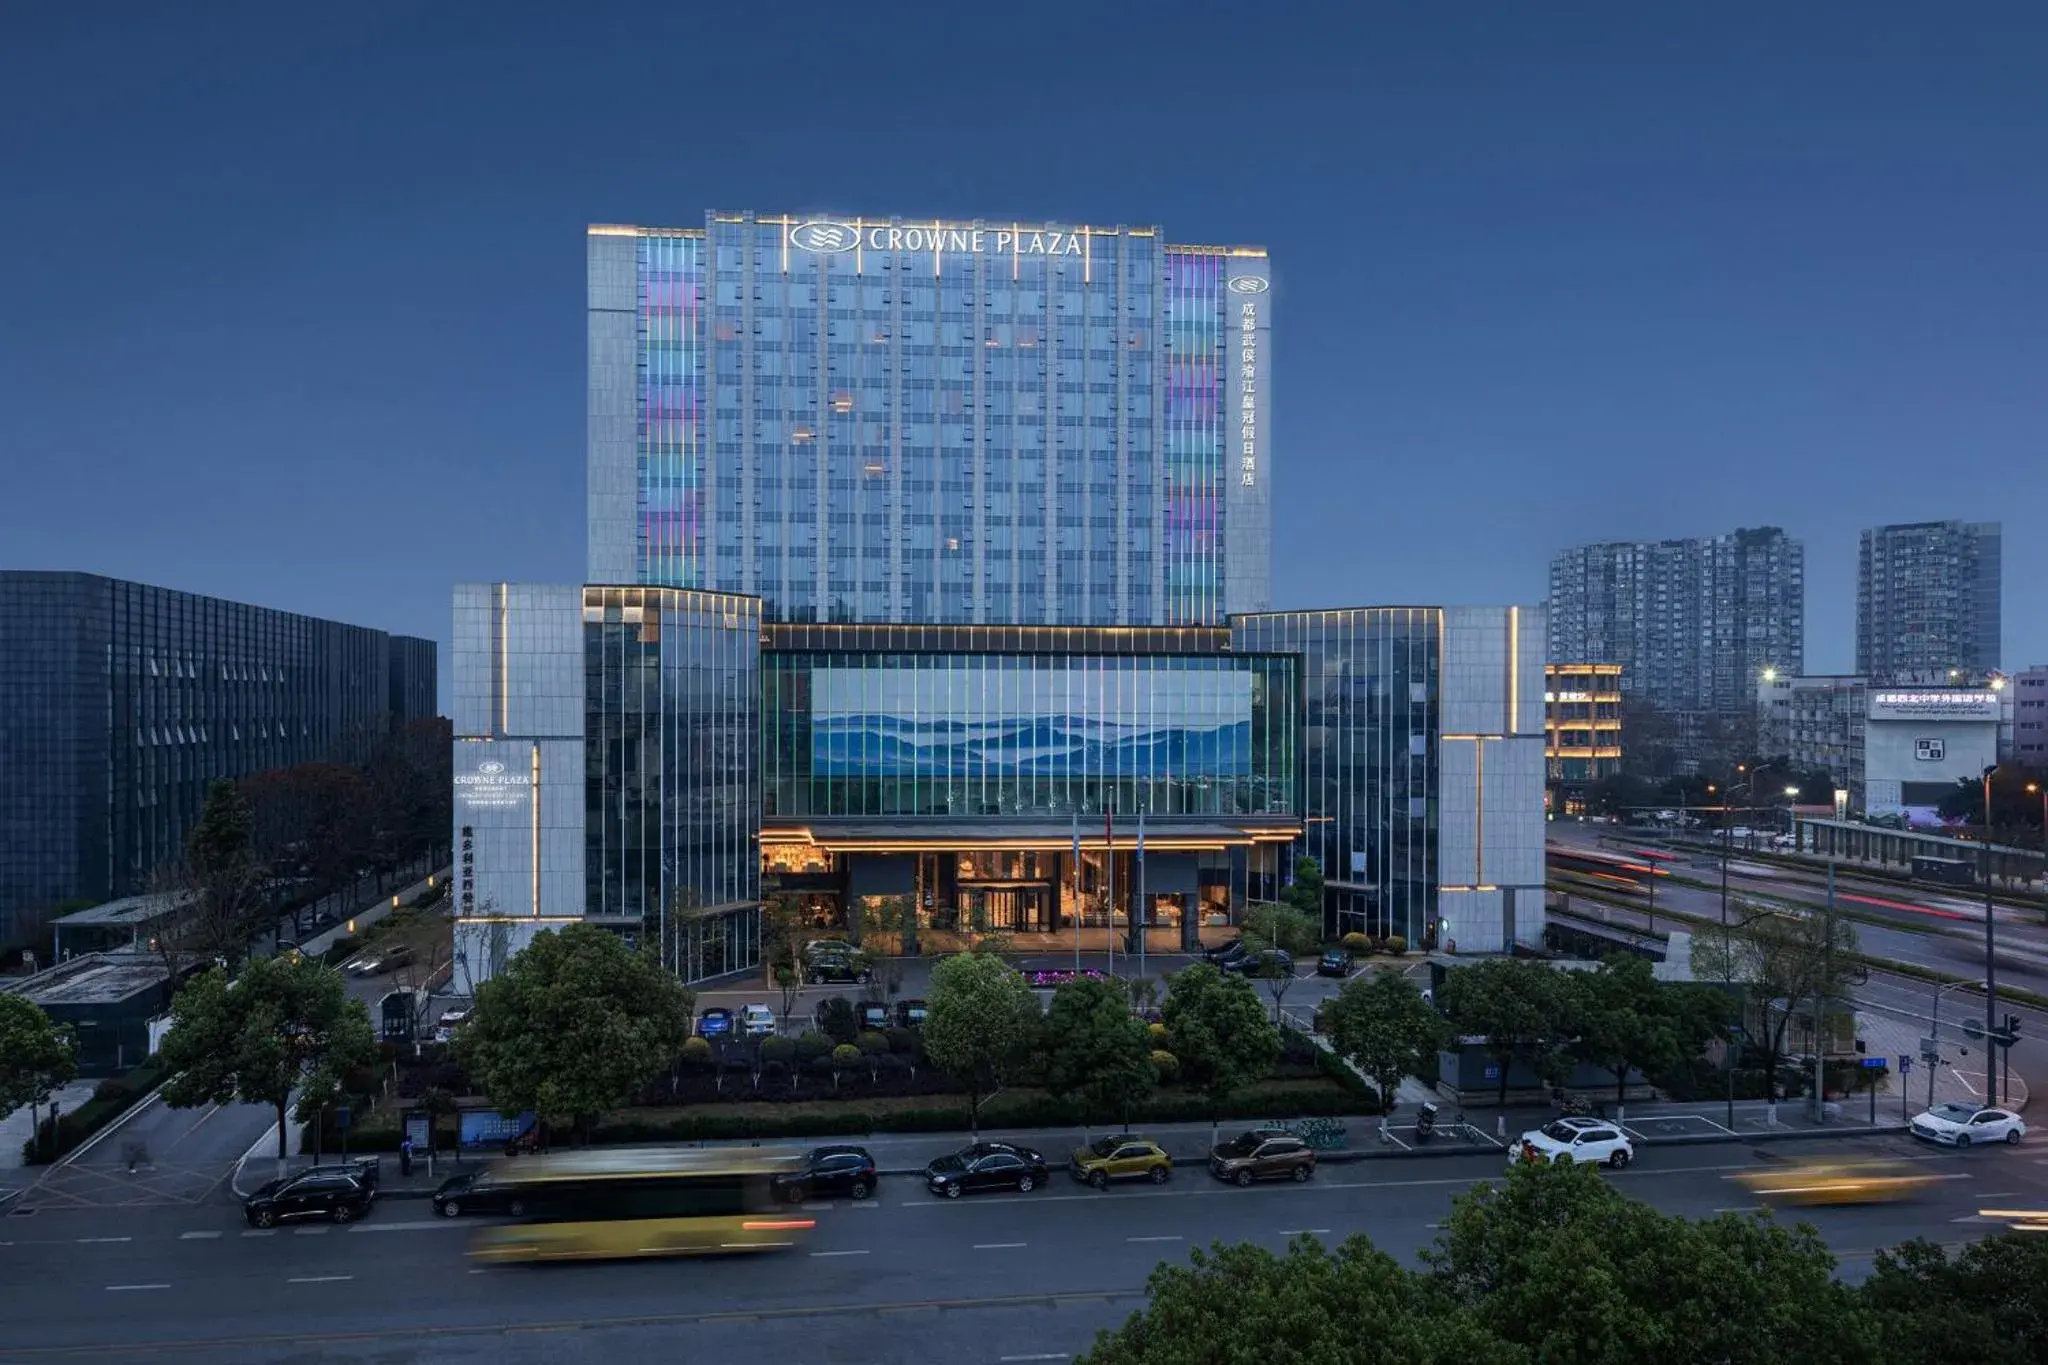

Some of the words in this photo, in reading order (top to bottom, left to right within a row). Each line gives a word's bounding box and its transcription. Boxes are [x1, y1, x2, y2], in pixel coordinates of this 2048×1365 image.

[870, 228, 984, 252] CROWNE
[997, 232, 1083, 255] PLAZA
[454, 776, 495, 785] CROWNE
[499, 776, 529, 785] PLAZA
